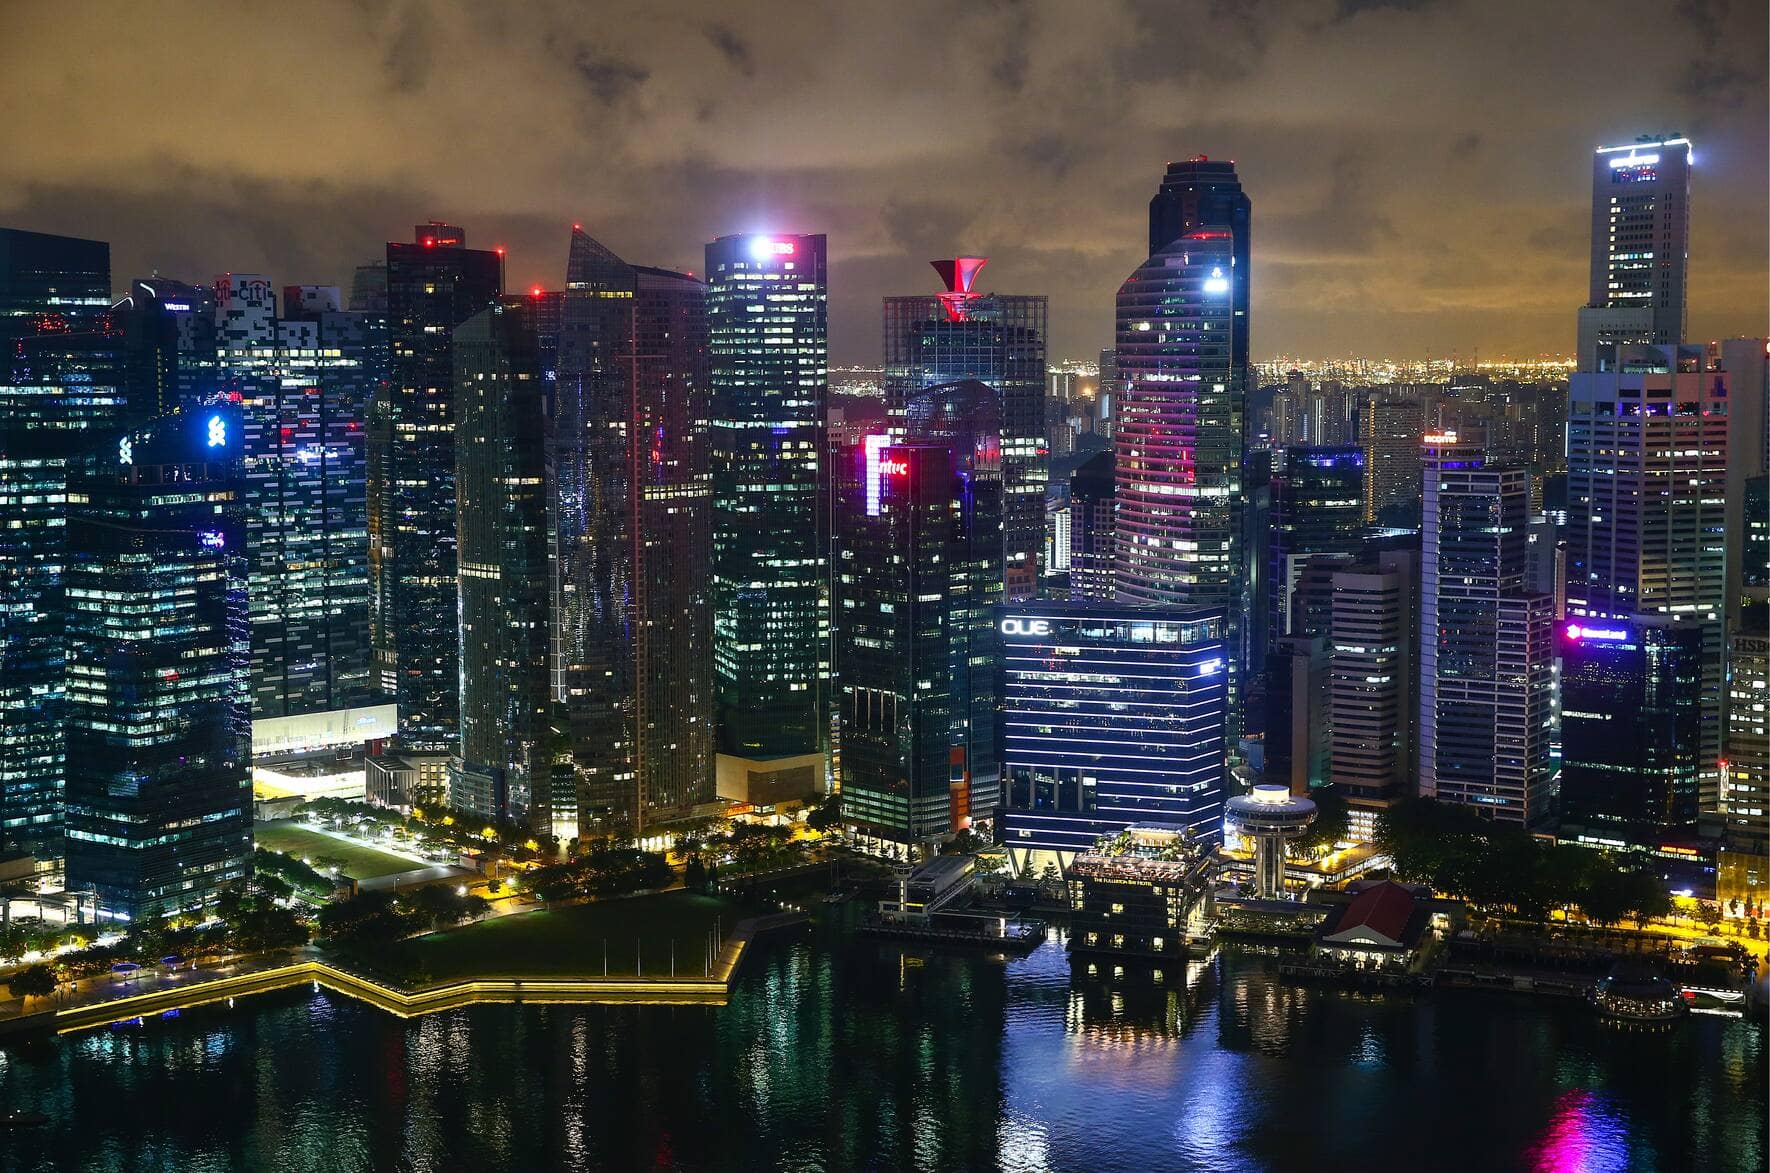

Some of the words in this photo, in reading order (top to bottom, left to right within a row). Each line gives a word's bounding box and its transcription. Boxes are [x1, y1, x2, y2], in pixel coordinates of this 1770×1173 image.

[238, 280, 267, 301] citi
[1424, 435, 1457, 443] income
[878, 460, 907, 475] ntuc
[1001, 619, 1049, 636] OUE
[1734, 638, 1769, 653] HSB
